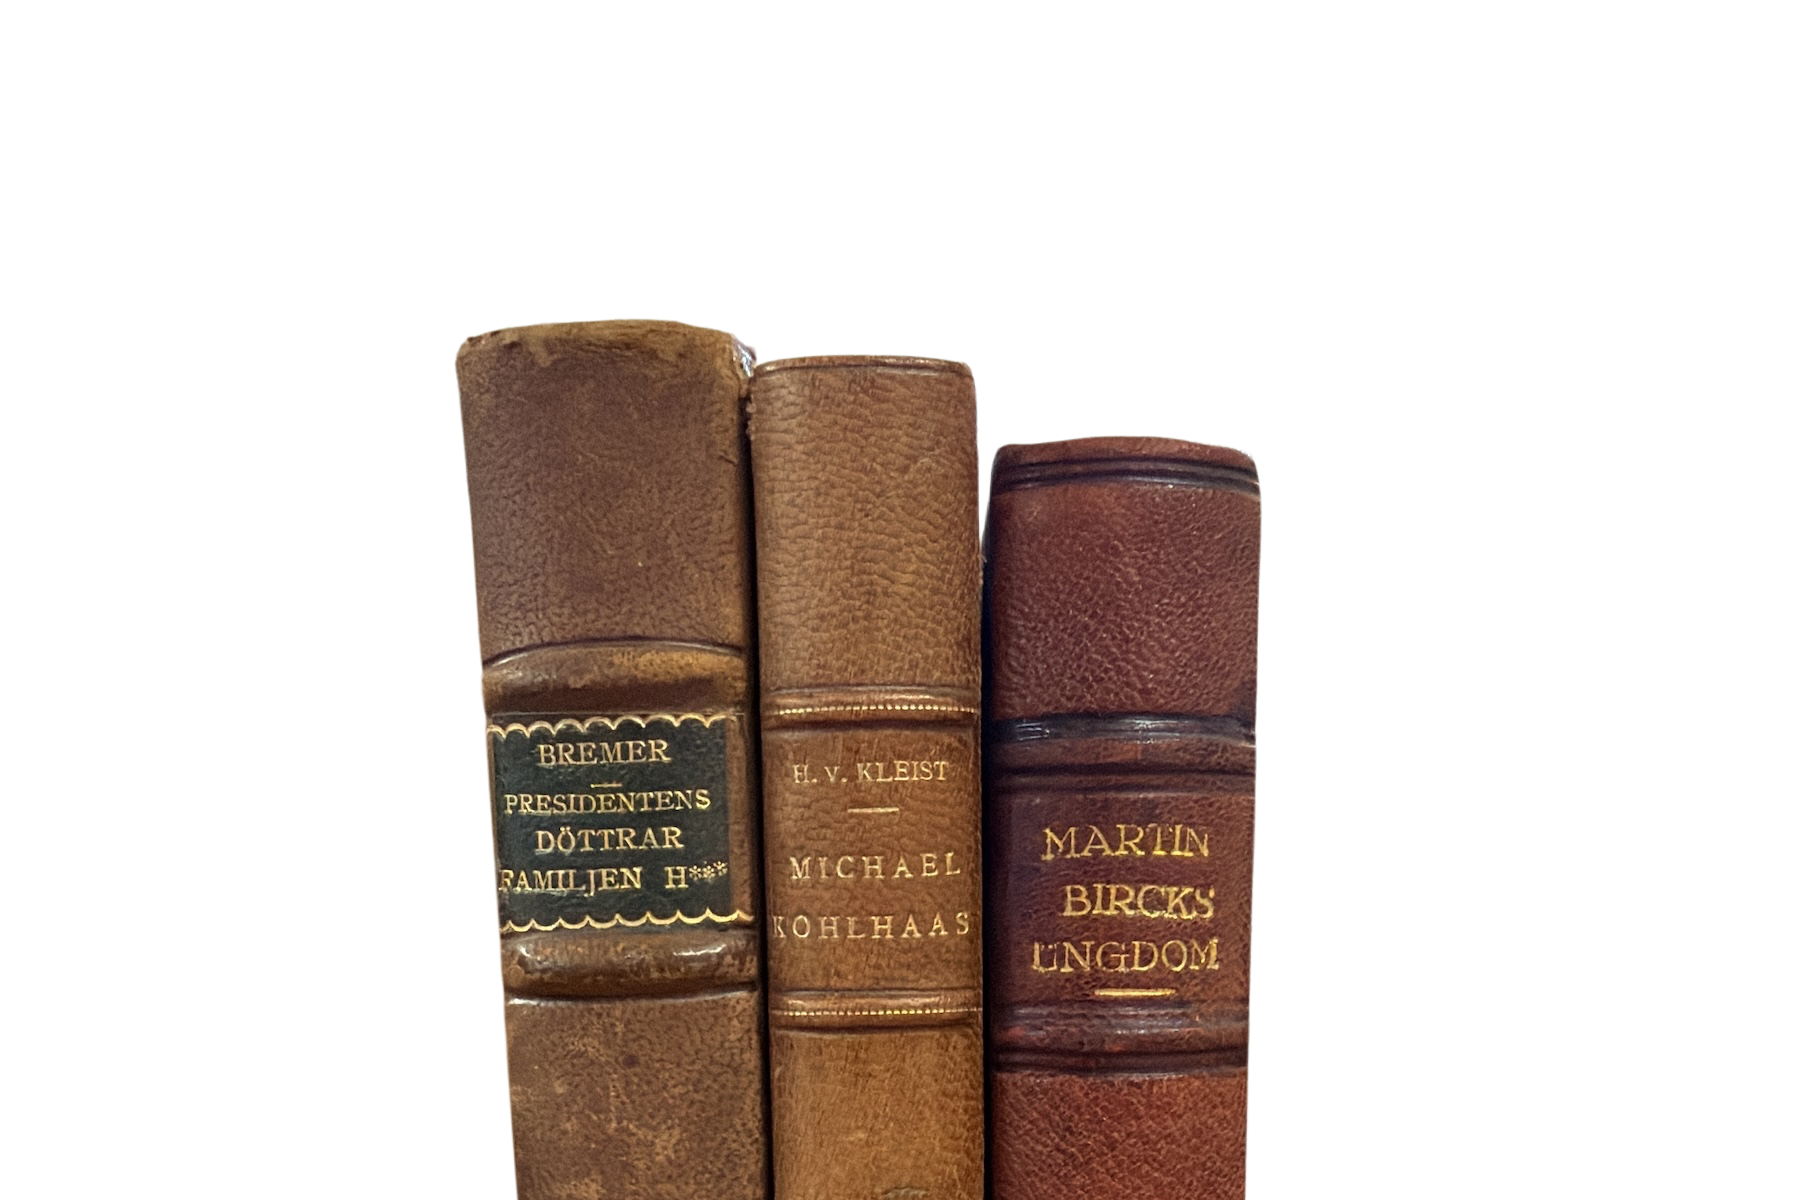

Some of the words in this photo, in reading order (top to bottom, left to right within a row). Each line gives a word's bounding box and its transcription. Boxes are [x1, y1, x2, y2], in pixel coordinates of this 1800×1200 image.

[536, 740, 672, 768] BREMER
[793, 764, 818, 784] H.
[857, 761, 949, 783] KLEIST
[504, 789, 711, 816] PRESIDENTENS
[535, 826, 684, 855] DÖTTRAR
[1041, 823, 1210, 861] MARTIN
[789, 852, 961, 880] MICHAEL
[498, 866, 643, 896] FAMILJEN
[1060, 883, 1216, 920] BIRCKS
[772, 911, 970, 939] KOHLHAAS
[1032, 937, 1220, 974] UNGDOM
